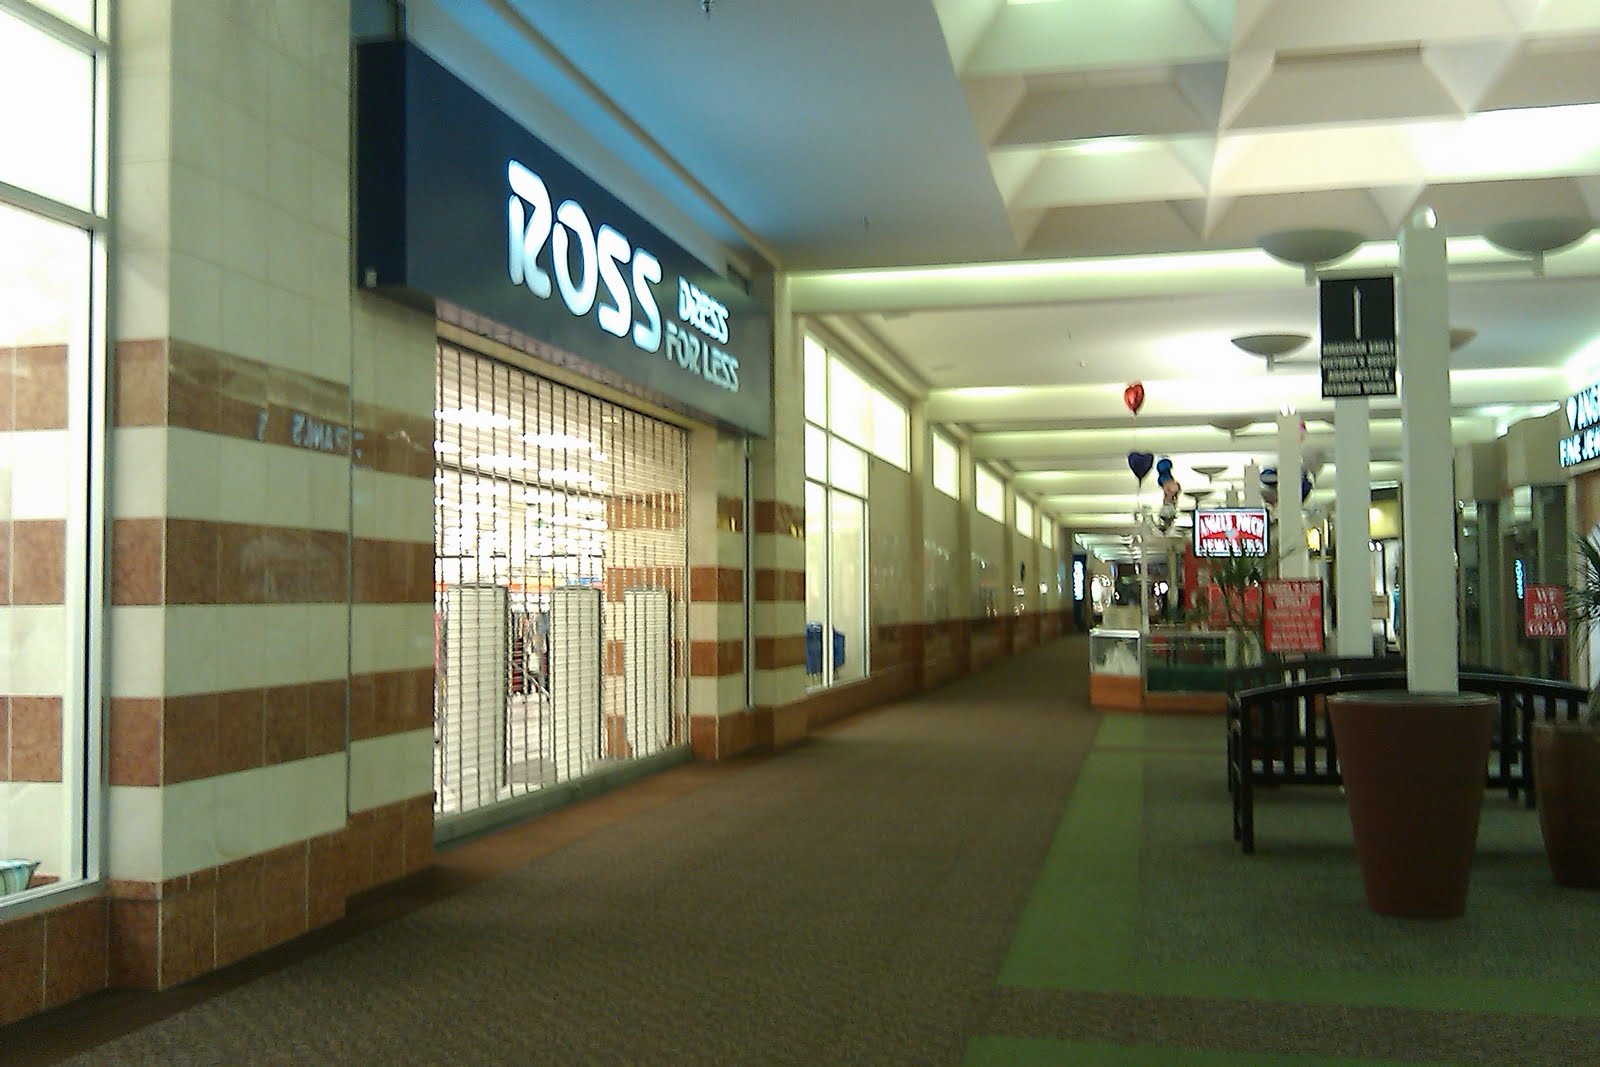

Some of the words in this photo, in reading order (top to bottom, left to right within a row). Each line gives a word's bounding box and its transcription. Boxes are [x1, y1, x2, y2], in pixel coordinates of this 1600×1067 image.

[507, 159, 662, 353] ROSS
[678, 275, 729, 345] DRESS
[664, 318, 700, 376] FOR
[701, 344, 740, 393] LESS
